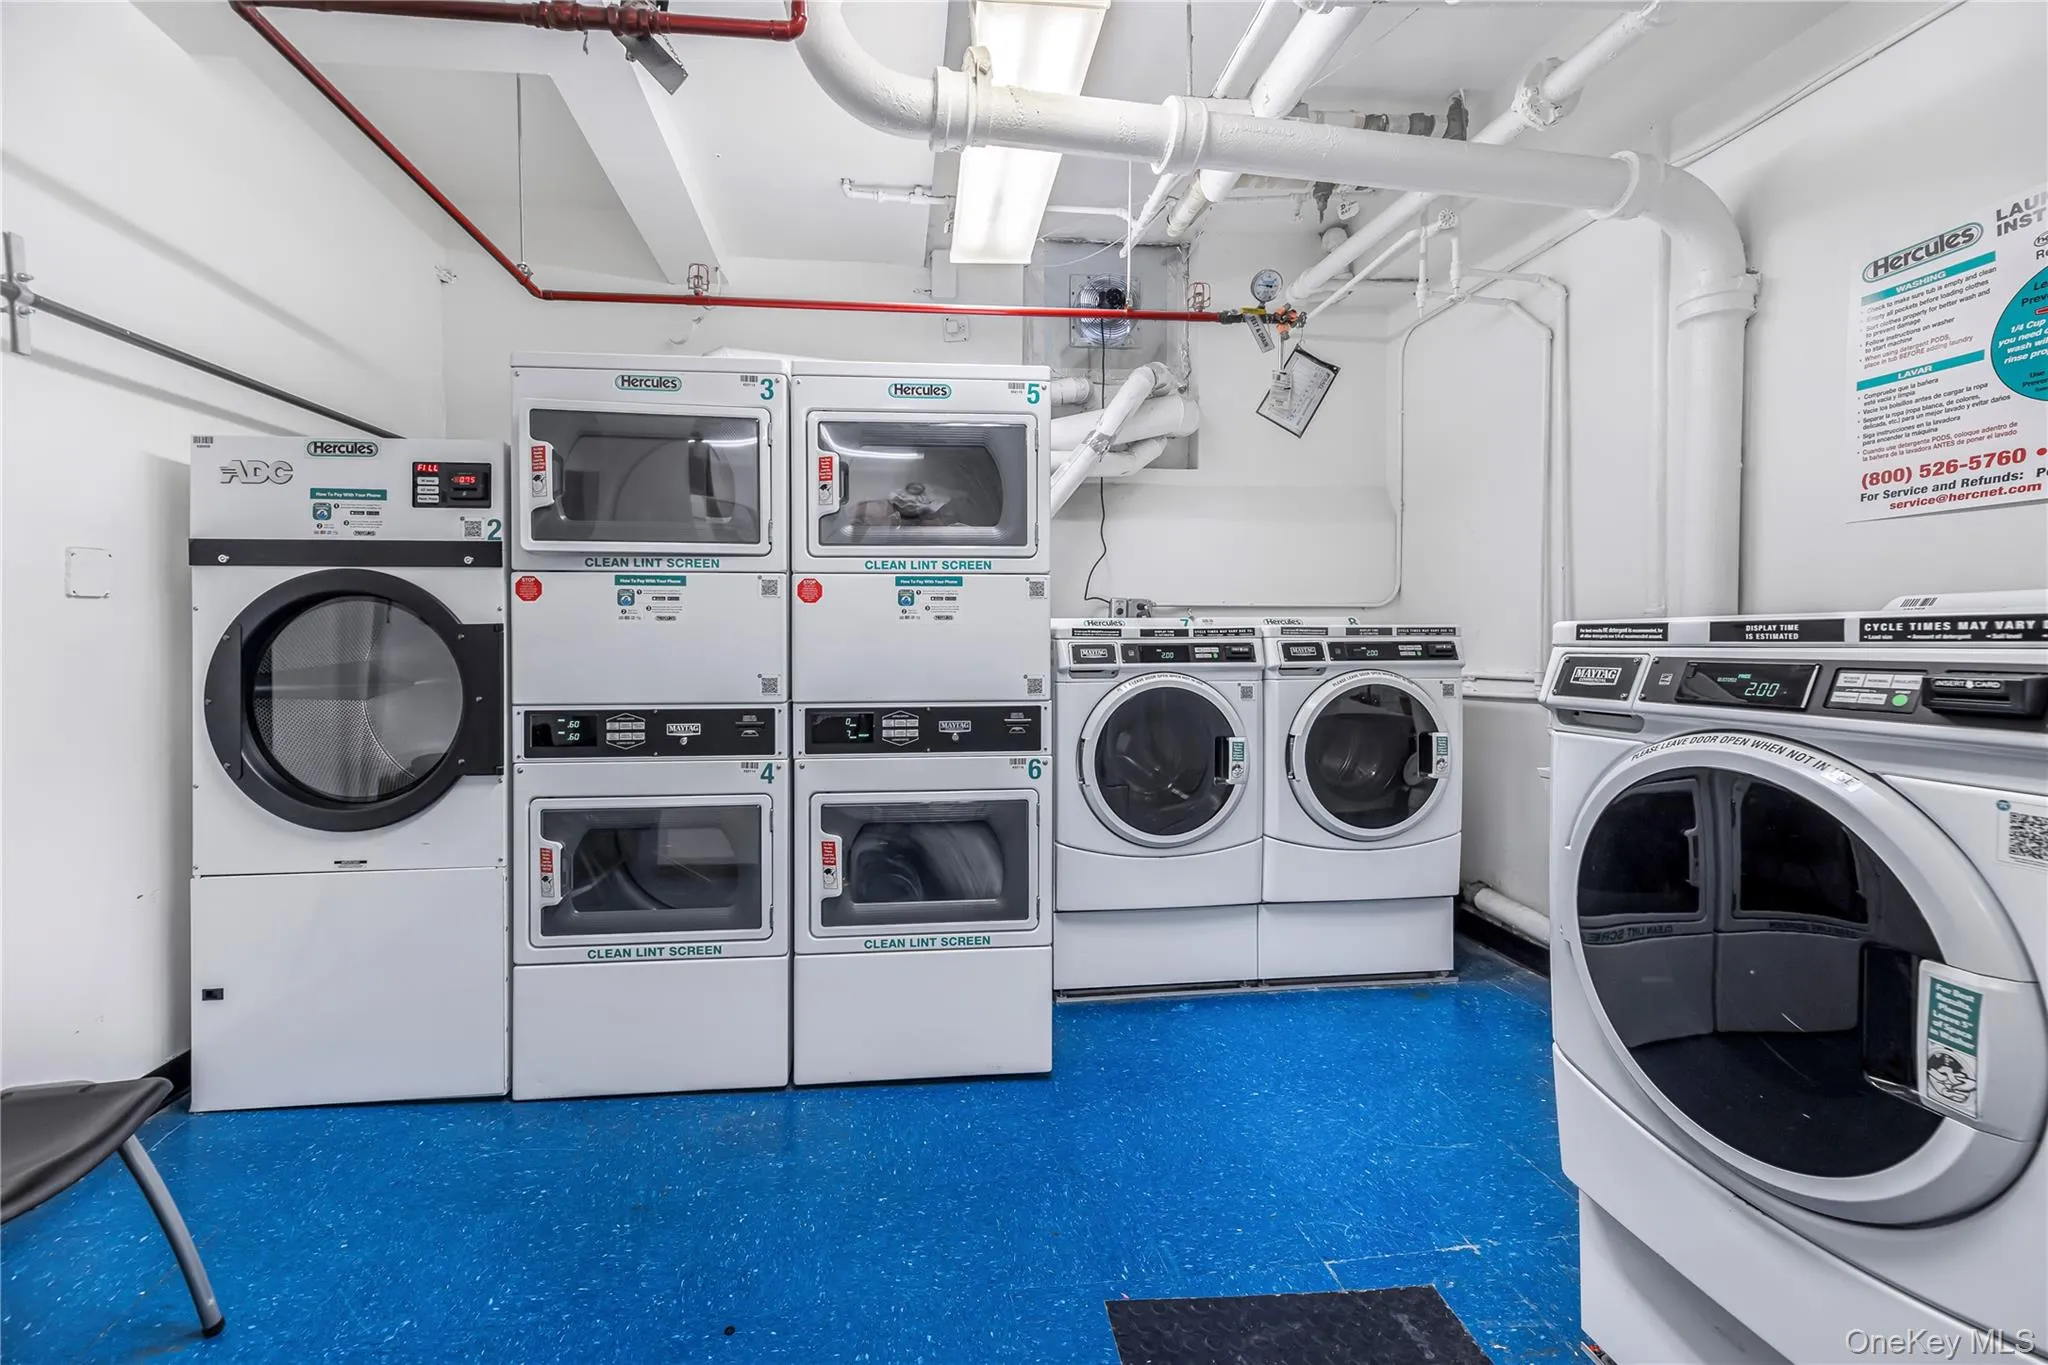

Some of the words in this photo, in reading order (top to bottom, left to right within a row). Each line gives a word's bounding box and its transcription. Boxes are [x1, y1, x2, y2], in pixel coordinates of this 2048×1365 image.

[1873, 228, 1974, 277] Hercules
[1894, 295, 1909, 305] make
[1911, 291, 1923, 299] sure
[1925, 287, 1935, 295] tub
[1944, 278, 1963, 289] empty
[1964, 273, 1976, 282] and
[1978, 266, 1996, 277] clean
[1896, 270, 1945, 293] WASHING
[1894, 302, 1917, 314] pockets
[1919, 295, 1938, 305] before
[1940, 287, 1962, 299] loading
[1965, 279, 1988, 290] clothes
[1879, 316, 1900, 327] clothes
[1903, 308, 1926, 321] properly
[1939, 298, 1957, 308] better
[1959, 293, 1975, 302] wash
[1977, 288, 1990, 297] and
[1873, 325, 1895, 336] prevent
[1897, 317, 1920, 329] damage
[2026, 319, 2046, 329] Cup
[1872, 343, 1886, 351] start
[1887, 336, 1912, 347] machine
[1998, 338, 2016, 348] you
[2018, 328, 2042, 340] need
[2008, 342, 2032, 353] wash
[1865, 353, 1880, 361] When
[1882, 348, 1897, 357] using
[1900, 339, 1928, 352] detergent
[2004, 354, 2028, 364] rinse
[621, 375, 678, 389] Hercules
[1897, 365, 1932, 379] LAVAR
[760, 378, 774, 400] 3
[894, 384, 948, 397] Hercules
[1027, 384, 1040, 404] 5
[1864, 387, 1895, 400] Compruebe
[1889, 399, 1912, 408] bolsillos
[1943, 388, 1963, 397] cargar
[1876, 424, 1914, 435] instrucciones
[1933, 415, 1960, 424] lavadora
[314, 442, 373, 454] Hercules
[220, 460, 293, 484] ADC
[418, 464, 438, 472] FILL
[1861, 466, 1911, 489] (800)
[1919, 447, 2026, 478] 526-5760
[1860, 491, 1879, 501] For
[1883, 484, 1927, 498] Service
[1931, 479, 1955, 491] and
[1960, 470, 2023, 487] Refunds:
[1889, 483, 2041, 509] service@hercnet.com
[488, 519, 502, 540] 2
[585, 558, 629, 568] CLEAN
[634, 558, 662, 568] LINT
[666, 558, 720, 568] SCREEN
[865, 560, 906, 570] CLEAN
[910, 560, 937, 570] LINT
[942, 560, 992, 570] SCREEN
[1864, 622, 1904, 631] CYCLE
[1910, 622, 1951, 630] TIMES
[1958, 621, 1988, 630] MAY
[1994, 620, 2036, 630] VARY
[1575, 669, 1616, 678] MAYTAG
[1744, 682, 1780, 697] 2.00
[1632, 745, 1658, 760] PLEASE
[1661, 738, 1689, 749] LEAVE
[1690, 736, 1718, 744] DOOR
[1720, 736, 1750, 746] OPEN
[1751, 740, 1788, 754] WHEN
[1786, 750, 1816, 764] NOT
[1812, 760, 1830, 771] IN
[760, 763, 774, 784] 4
[1028, 759, 1041, 779] 6
[588, 948, 632, 959] CLEAN
[636, 947, 665, 958] LINT
[670, 946, 722, 956] SCREEN
[864, 938, 906, 949] CLEAN
[910, 938, 937, 948] LINT
[941, 936, 990, 946] SCREEN
